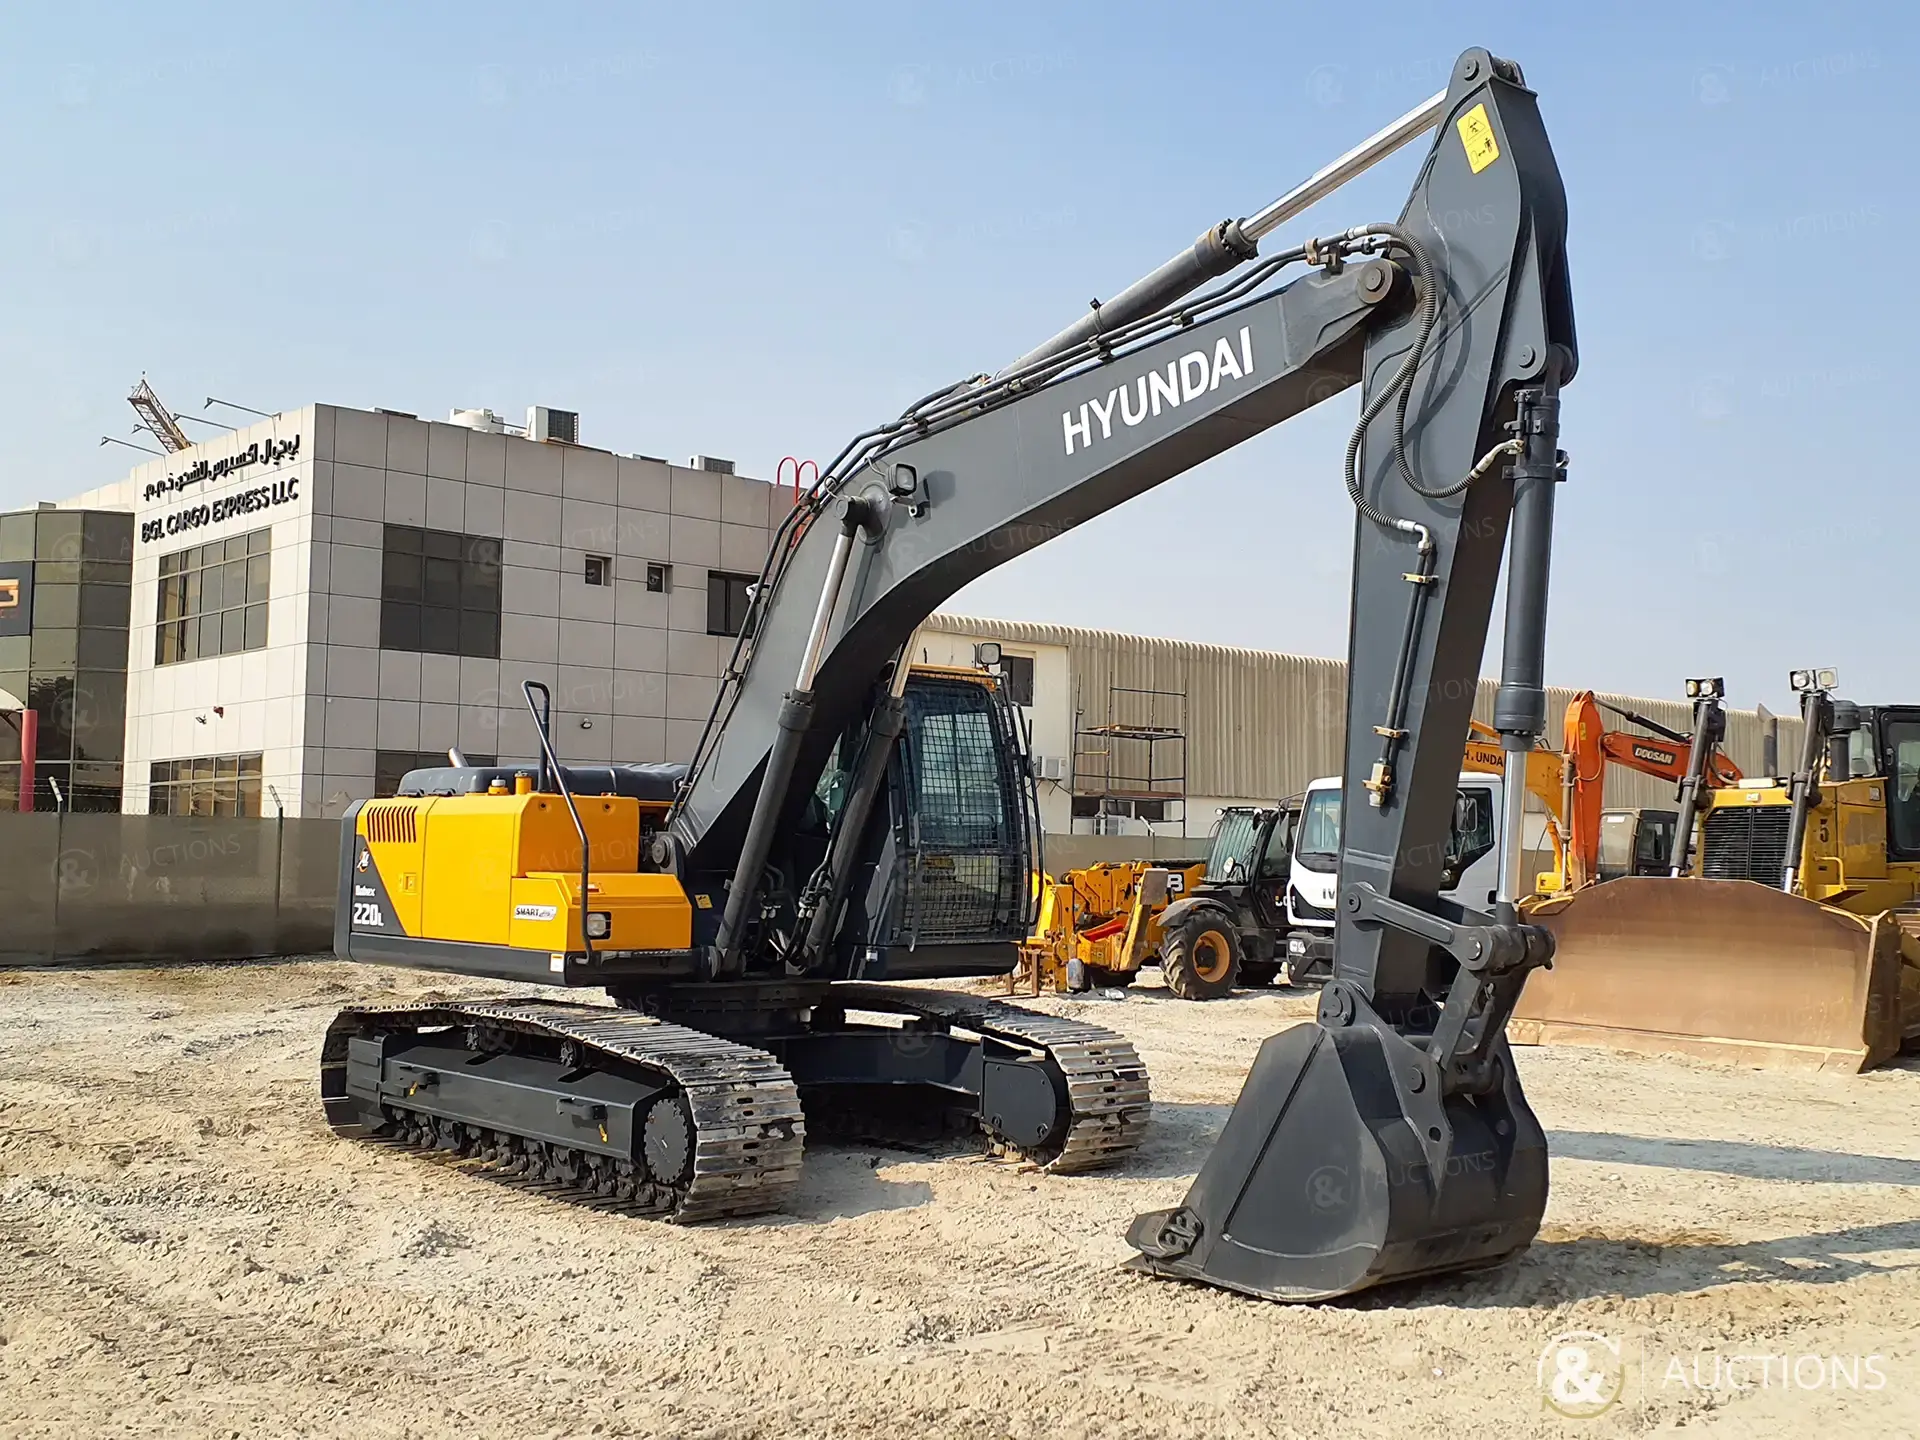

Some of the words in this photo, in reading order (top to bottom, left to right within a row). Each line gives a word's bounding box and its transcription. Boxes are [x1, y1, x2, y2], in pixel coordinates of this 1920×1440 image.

[1062, 326, 1254, 456] HYUNDAI
[141, 518, 165, 543] BGL
[166, 504, 210, 535] CARGO
[212, 486, 270, 523] EXPRESS
[272, 477, 299, 505] LLC
[1465, 750, 1504, 767] HUNDA
[1635, 747, 1673, 765] DOOSAN
[1819, 819, 1829, 843] 5
[1322, 888, 1336, 900] IV
[353, 902, 385, 927] 220L
[515, 907, 540, 917] SMART
